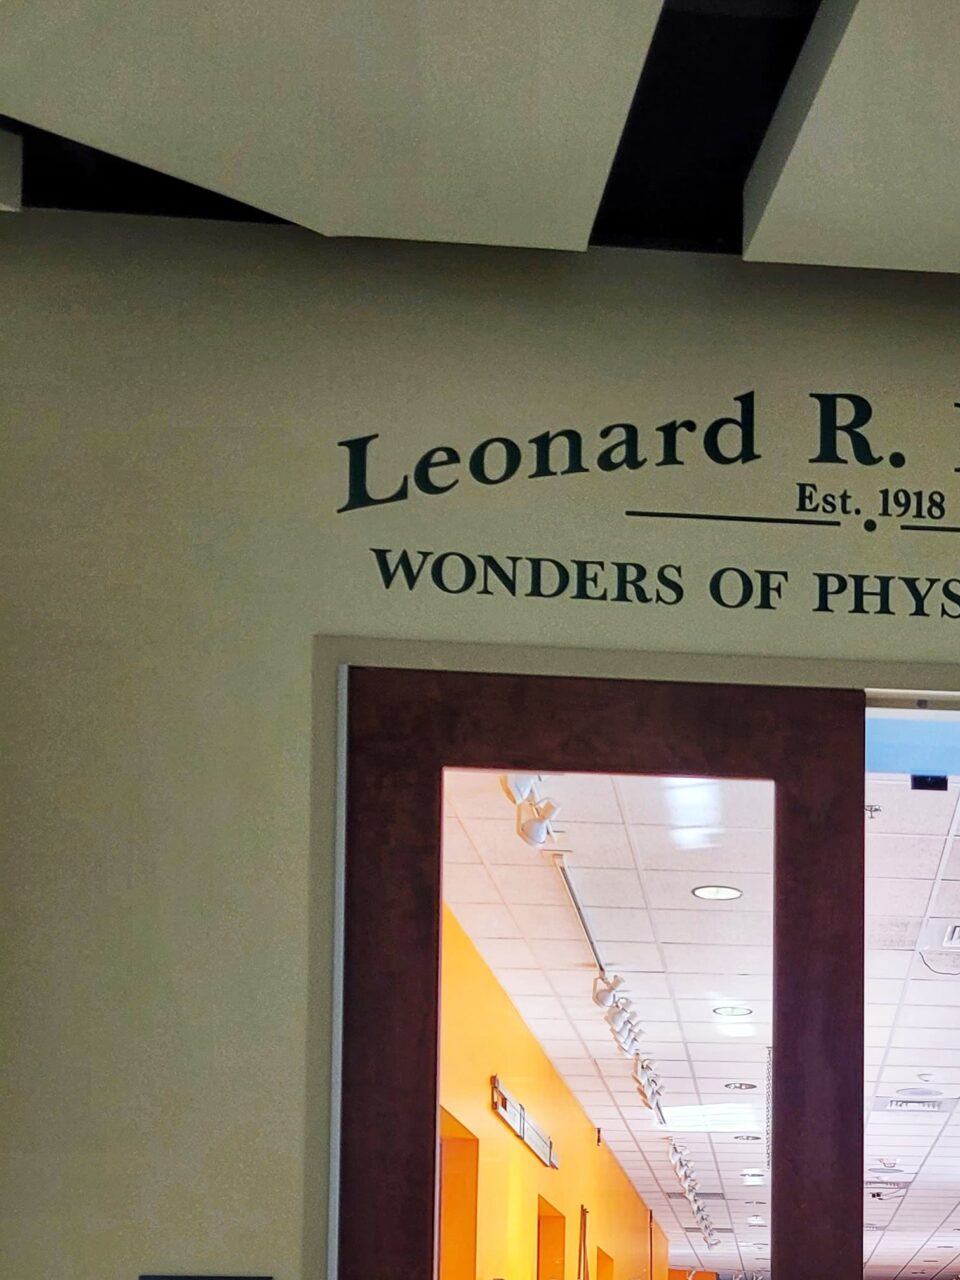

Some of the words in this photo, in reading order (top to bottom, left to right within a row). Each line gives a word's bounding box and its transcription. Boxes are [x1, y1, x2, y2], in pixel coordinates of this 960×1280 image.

[337, 390, 762, 514] Leonard
[808, 392, 906, 469] R.
[795, 482, 862, 515] Est.
[878, 488, 946, 520] 1918
[369, 547, 685, 606] WONDERS
[709, 566, 789, 610] OF
